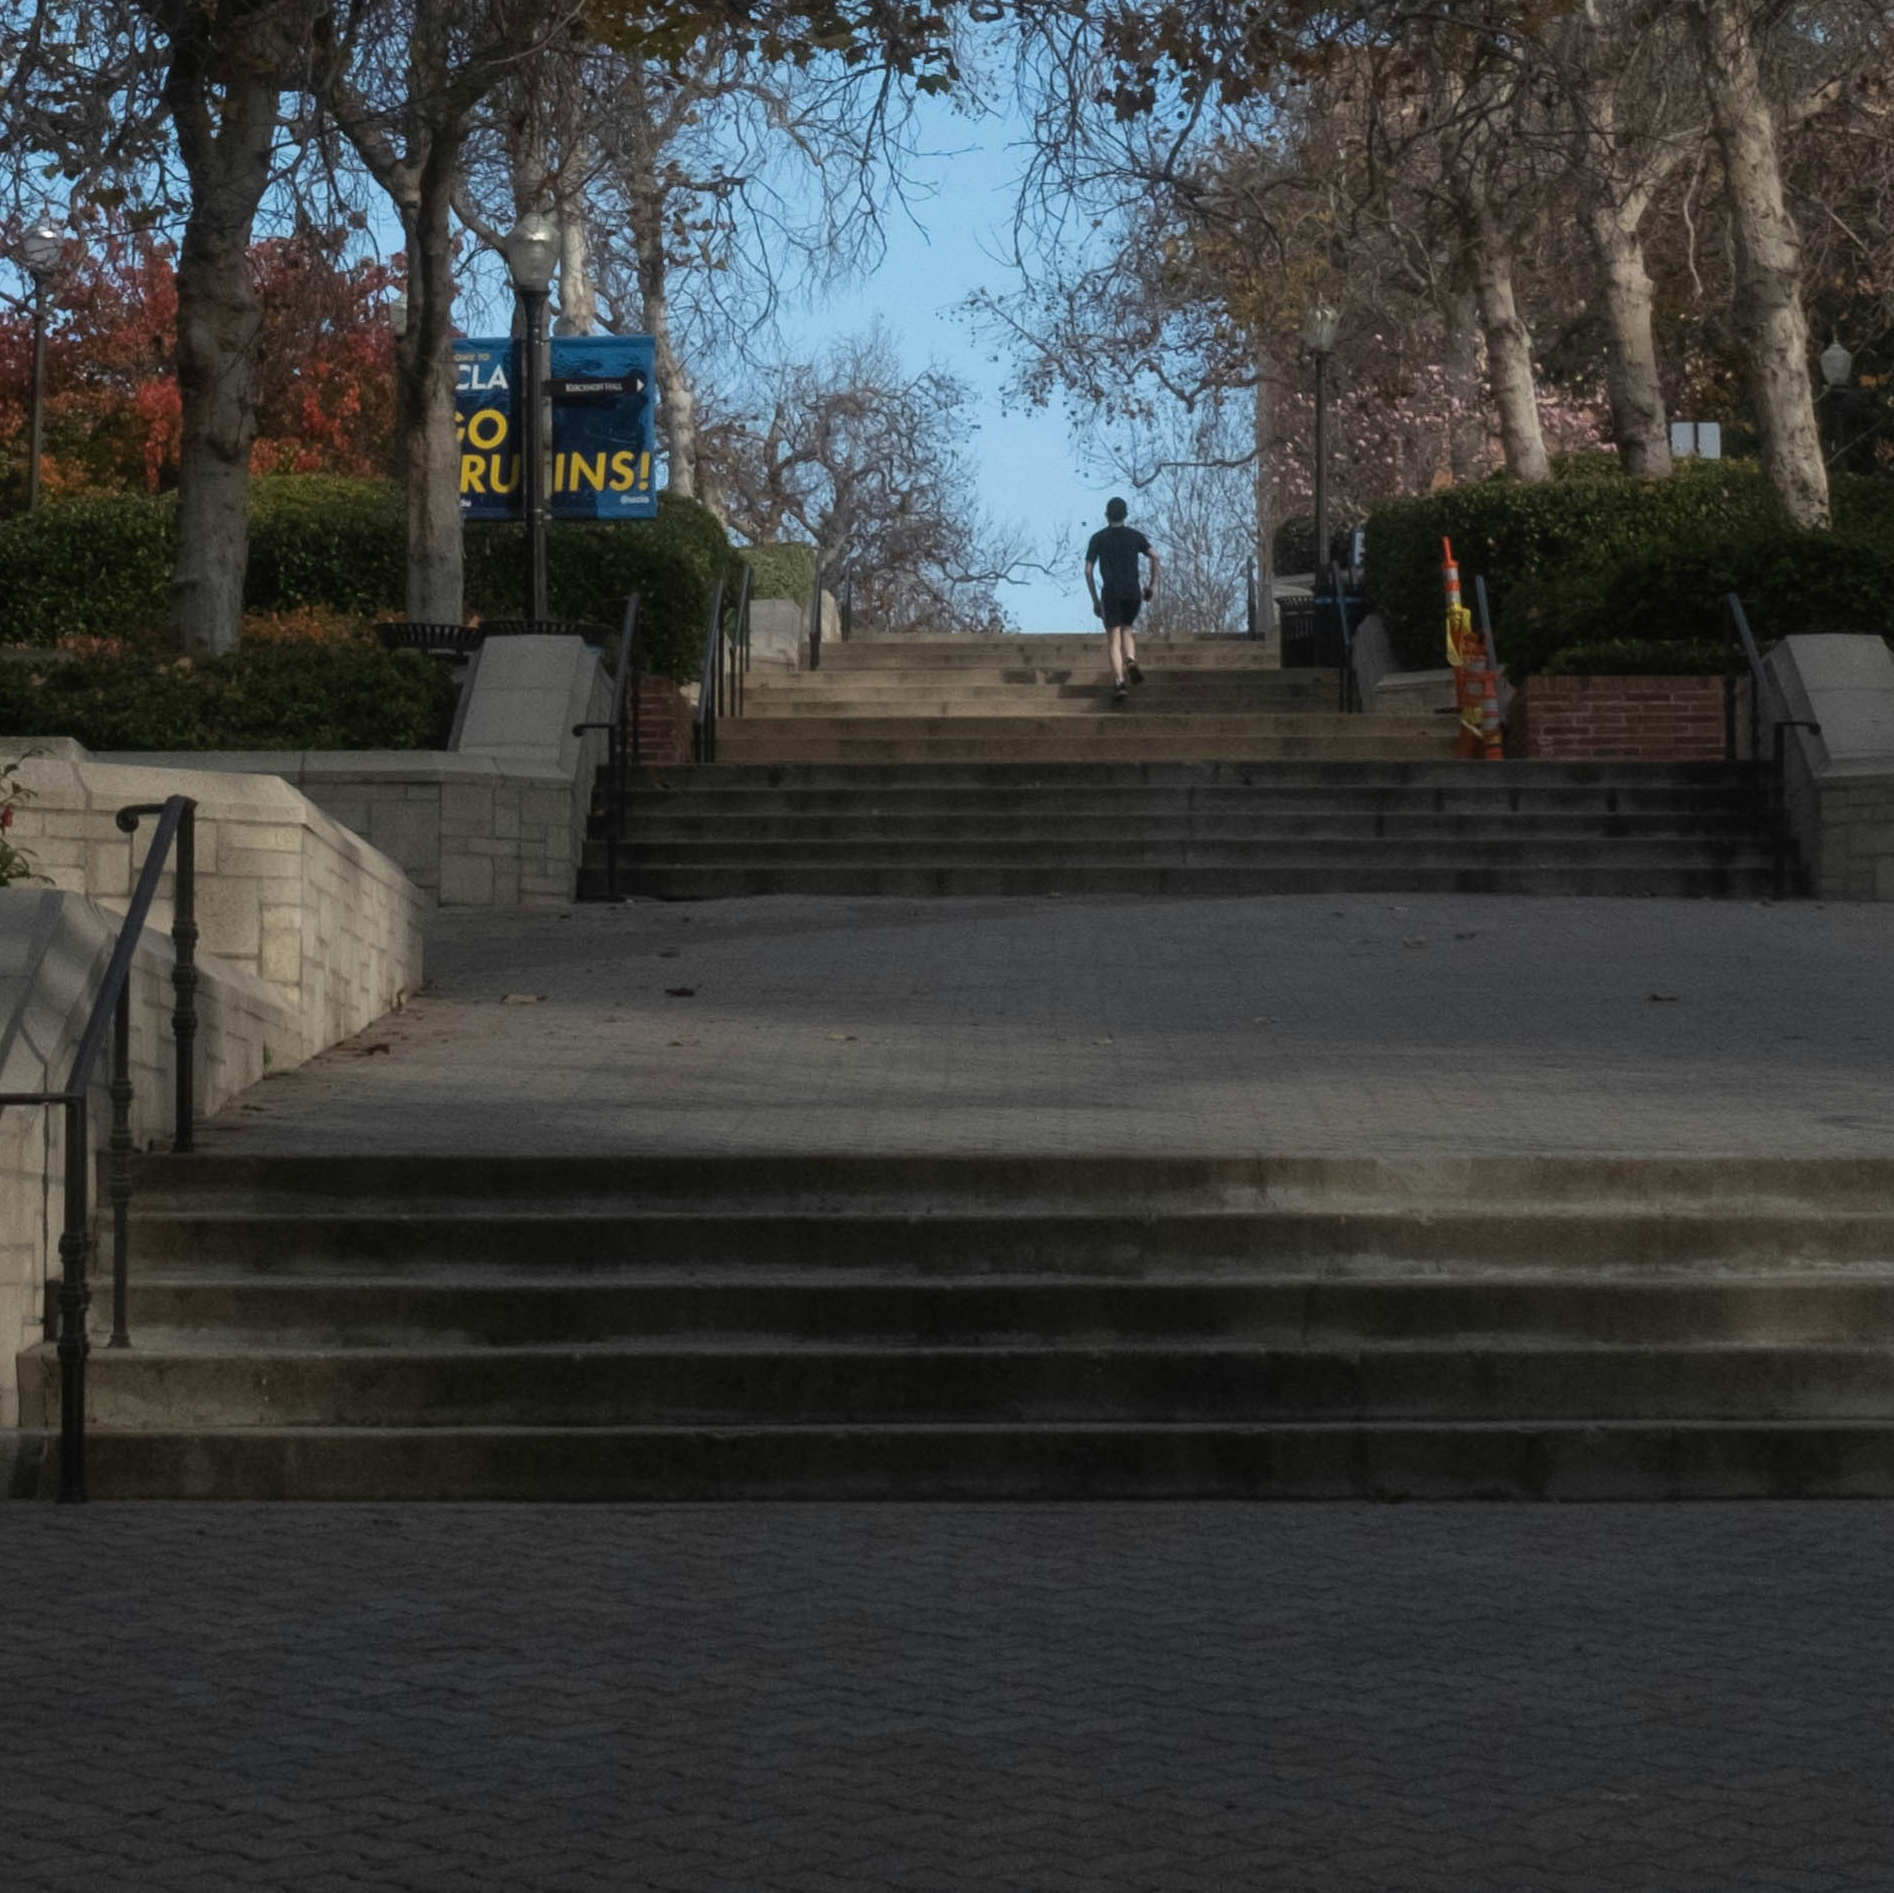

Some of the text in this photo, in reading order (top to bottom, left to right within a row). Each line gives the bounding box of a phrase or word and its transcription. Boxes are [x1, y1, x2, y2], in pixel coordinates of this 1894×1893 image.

[456, 364, 509, 390] CLA
[454, 408, 508, 450] O
[459, 453, 522, 494] RU
[554, 451, 651, 492] INS!
